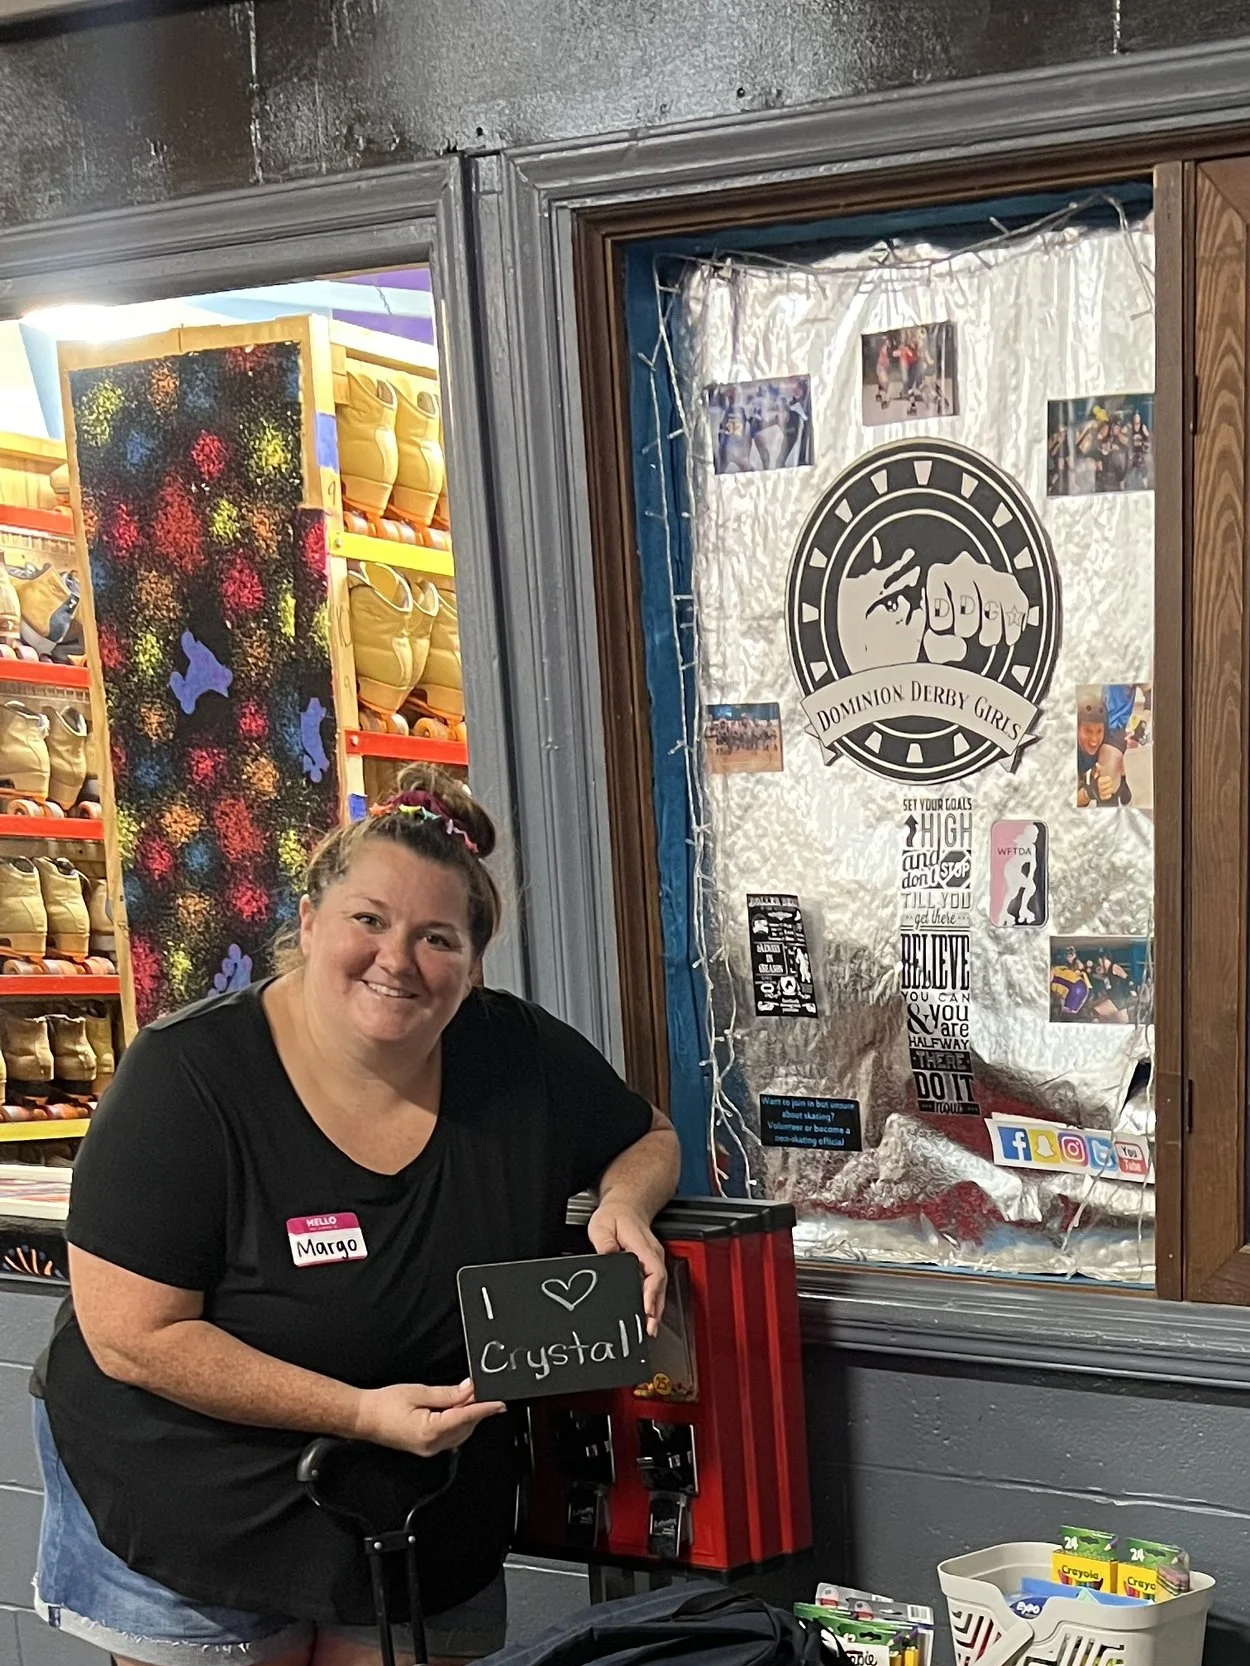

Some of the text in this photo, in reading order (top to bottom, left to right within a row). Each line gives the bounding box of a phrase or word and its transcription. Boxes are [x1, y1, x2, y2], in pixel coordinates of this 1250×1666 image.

[816, 680, 1022, 741] DOMINION DERBY GIRLS
[903, 798, 972, 811] SET YOUR GOALS
[921, 813, 972, 848] HIGH
[902, 847, 942, 872] and
[998, 847, 1032, 856] WFTDA
[940, 861, 971, 878] STOP
[902, 892, 971, 909] TILL YOU
[914, 909, 956, 929] get there
[901, 933, 970, 990] BELIEVE
[902, 991, 970, 1003] YOU CAN
[907, 1003, 969, 1035] & you
[941, 1021, 969, 1037] are
[908, 1036, 969, 1050] HALFWAY
[916, 1051, 967, 1069] THERE
[913, 1072, 975, 1101] DO IT
[1121, 1146, 1137, 1158] You
[306, 1216, 337, 1227] HELLO
[297, 1239, 357, 1260] Margo
[481, 1286, 494, 1319] I
[480, 1313, 646, 1380] Crystal!
[1064, 1536, 1079, 1550] 24
[1130, 1548, 1145, 1562] 24
[1061, 1564, 1100, 1579] Crayola
